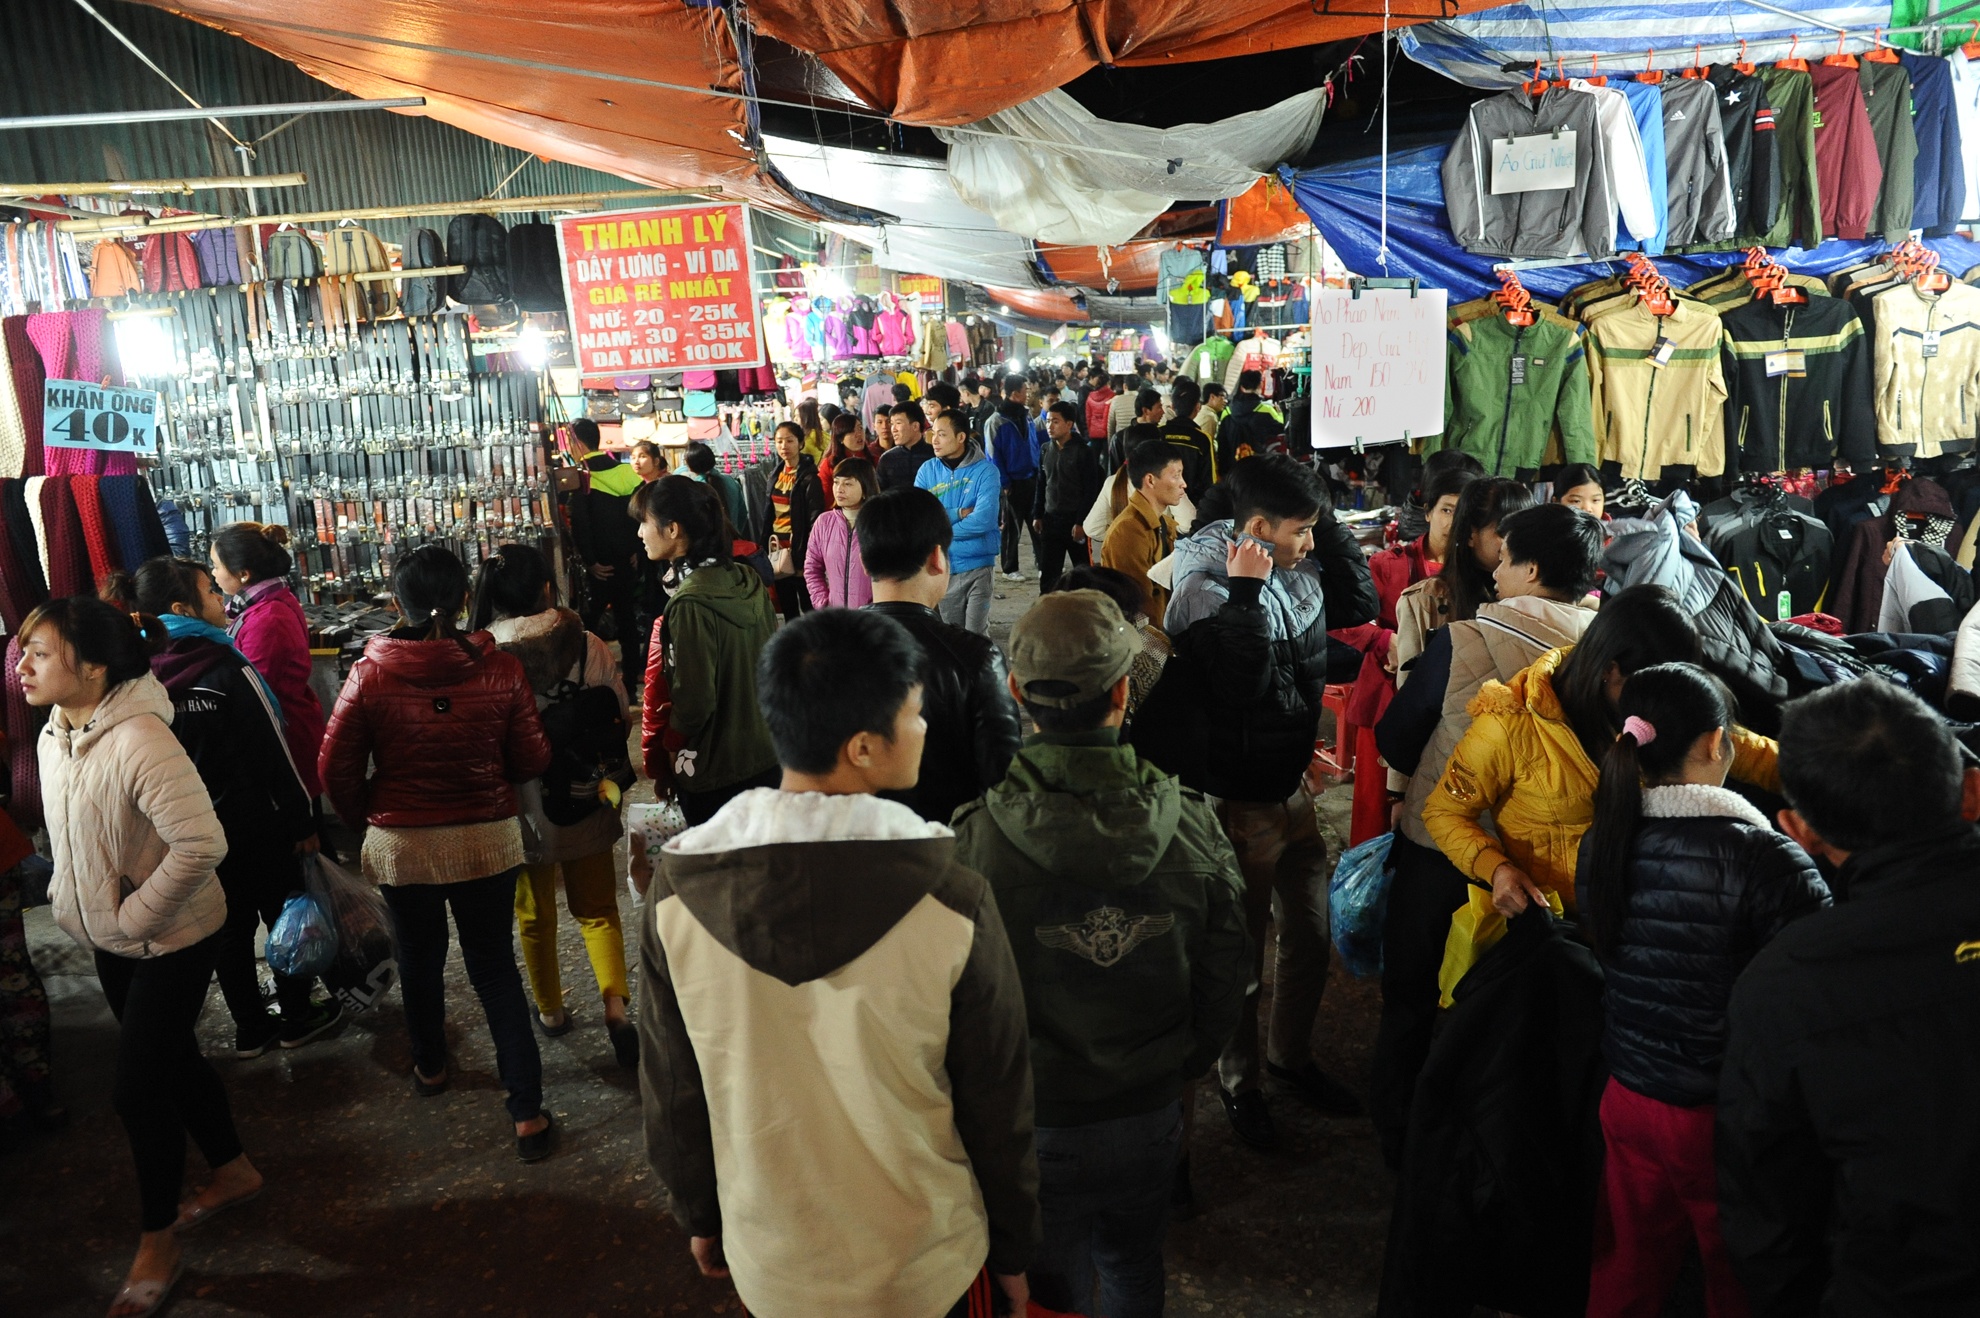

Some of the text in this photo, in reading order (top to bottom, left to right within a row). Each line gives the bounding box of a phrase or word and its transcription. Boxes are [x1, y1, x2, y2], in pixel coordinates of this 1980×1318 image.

[577, 209, 728, 251] THANH LÝ
[577, 255, 612, 282] DÂY
[619, 251, 667, 279] LƯNG
[684, 247, 706, 274] VÍ
[712, 248, 739, 272] DA
[589, 273, 732, 306] GIÁ RẺ NHẤT
[589, 309, 627, 330] NỮ:
[633, 308, 665, 326] 20
[688, 303, 738, 322] 25K
[580, 331, 639, 350] NAM:
[645, 327, 678, 345] 30
[701, 321, 751, 341] 35K
[592, 342, 744, 368] DA XỊN: 100K
[1325, 363, 1352, 390] Nam
[47, 386, 153, 415] KHĂN ÔNG
[1352, 395, 1376, 417] 200
[188, 696, 217, 712] HÀNG
